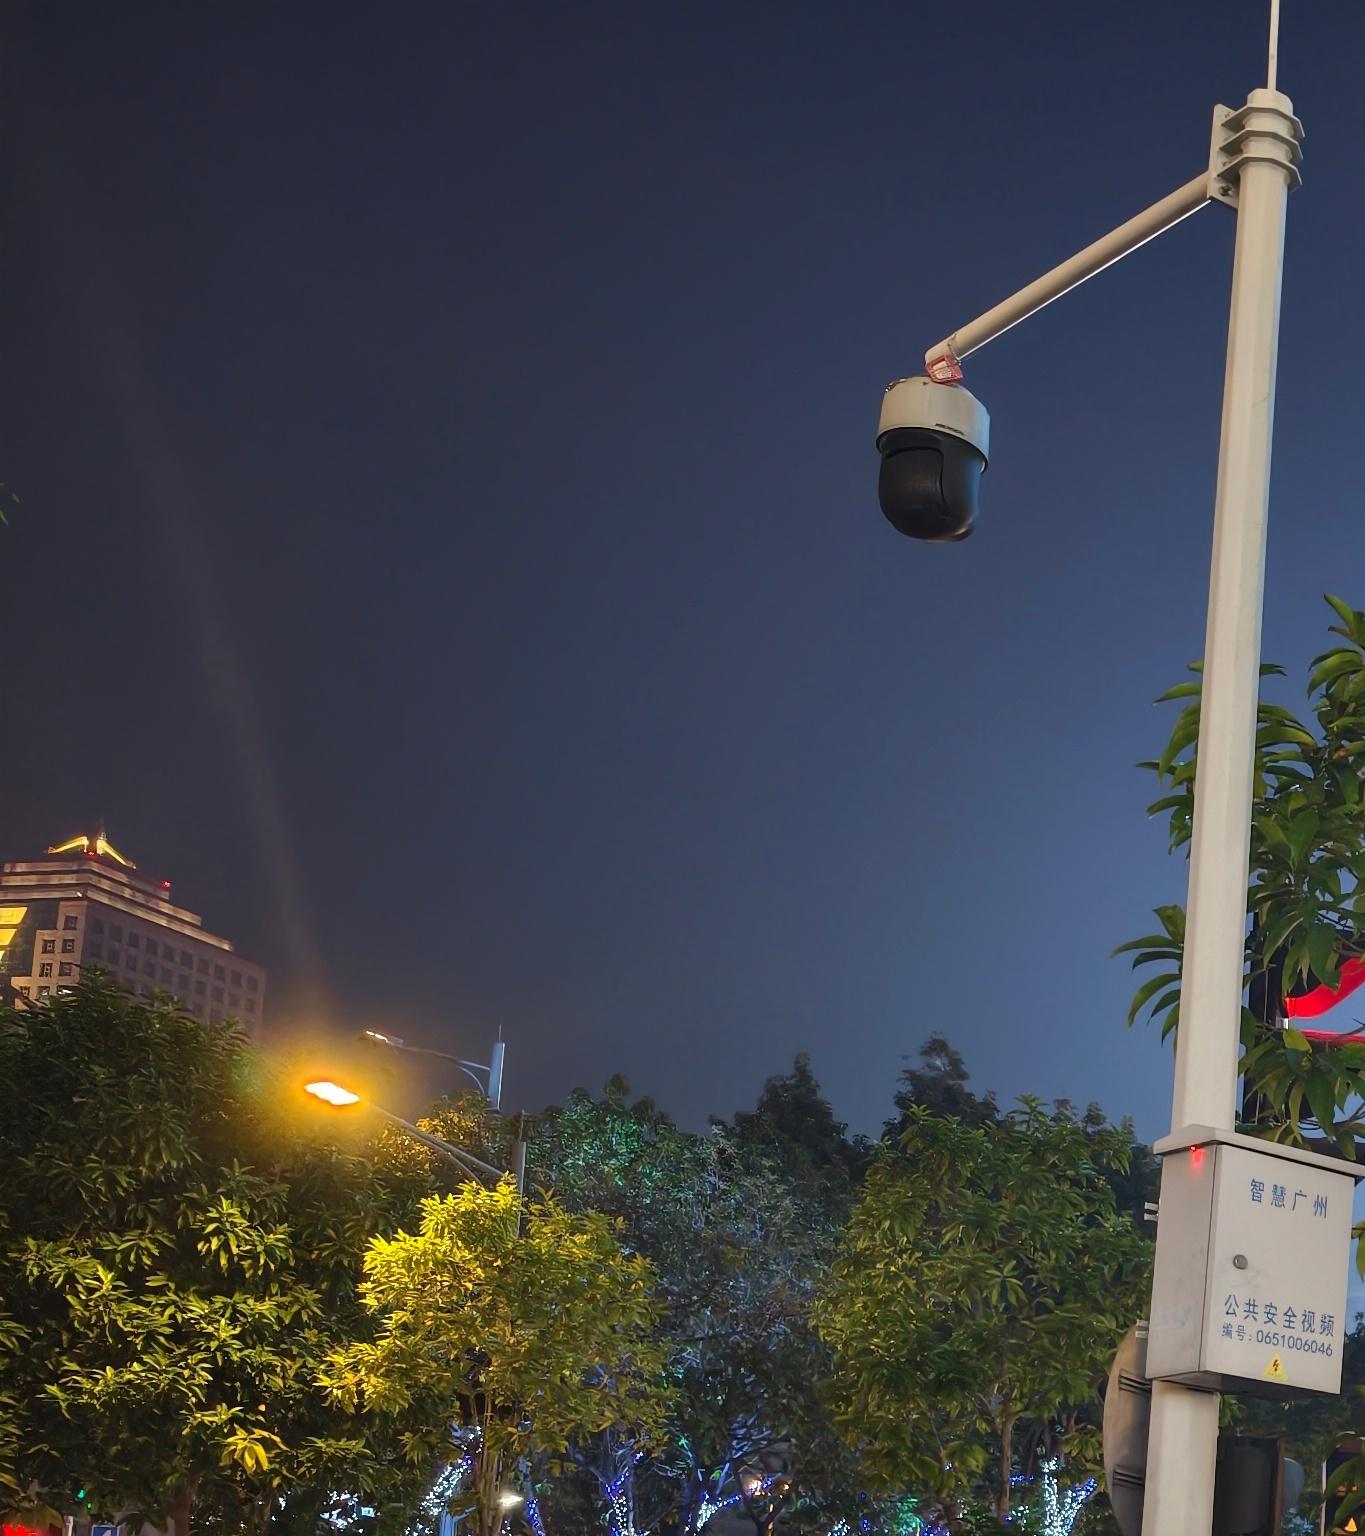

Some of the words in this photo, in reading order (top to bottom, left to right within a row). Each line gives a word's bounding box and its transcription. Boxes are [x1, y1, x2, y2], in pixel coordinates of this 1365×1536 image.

[1250, 1178, 1328, 1218] 智慧广州
[1224, 1294, 1336, 1338] 公共安全视频
